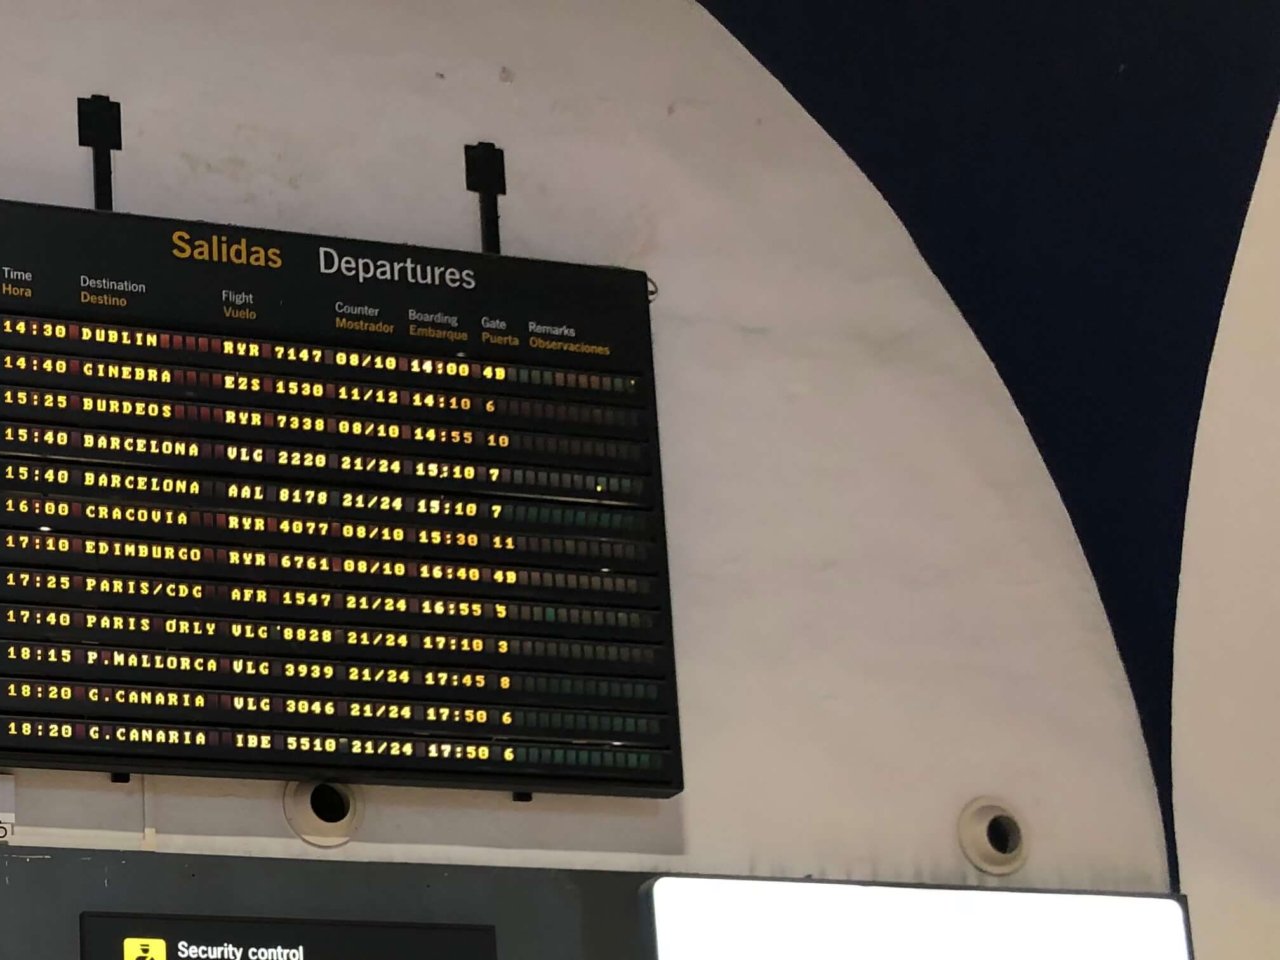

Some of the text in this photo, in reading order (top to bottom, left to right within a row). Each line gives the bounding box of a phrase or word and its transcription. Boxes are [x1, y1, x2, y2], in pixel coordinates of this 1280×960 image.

[171, 230, 477, 290] Salidas Departures
[2, 267, 576, 338] Time Destination Flight Counter Boarding Gate Remarks
[2, 283, 611, 356] Hora Destino Vuelo Mostrador Embarque Puerta Observaciones
[3, 320, 157, 347] 14:30 DUBLIN
[4, 355, 171, 383] 14:40 GINEBRA
[4, 390, 172, 418] 15:25 BURDEOS
[5, 427, 500, 482] 15:40 BARCELONA VLG 2220 21/24 15:10 7
[5, 465, 200, 494] 15:40 BARCELONA
[5, 499, 514, 549] 16:00 CRACOVIA RYR 4077 08/10 15:30 11
[6, 535, 201, 561] 17:10 EDIMBURGO
[6, 573, 482, 616] 17:25 PARIS/CDG AFR 1547 21/24 16:55
[7, 610, 216, 635] 17:40 PARIS ORLY
[7, 646, 217, 672] 18:15 P.MALLORCA
[8, 683, 512, 724] 18:20 G.CANARIA VLG 3046 21/24 17:50 6
[8, 722, 206, 745] 18:20 G.CANARIA
